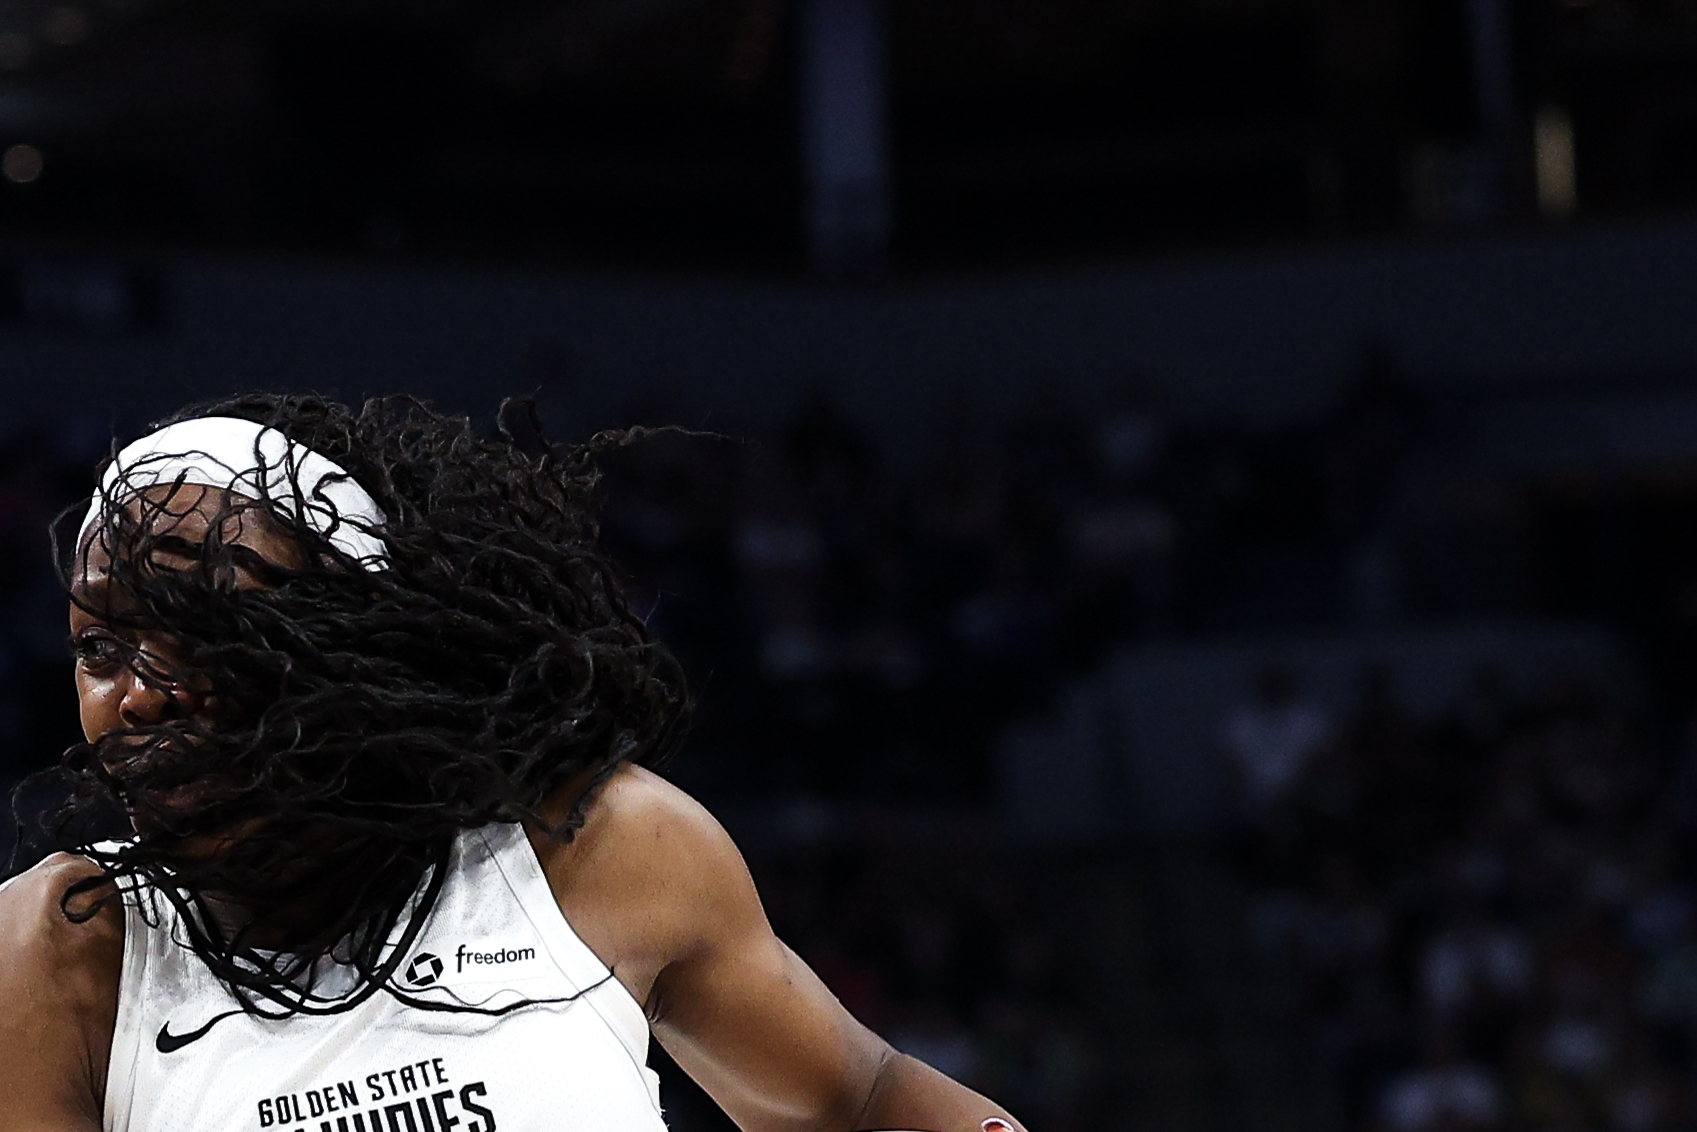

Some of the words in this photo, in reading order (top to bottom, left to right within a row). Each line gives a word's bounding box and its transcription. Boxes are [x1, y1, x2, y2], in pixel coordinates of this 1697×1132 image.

[455, 943, 536, 974] freedom
[257, 1080, 360, 1128] GOLDEN
[365, 1057, 449, 1101] STATE
